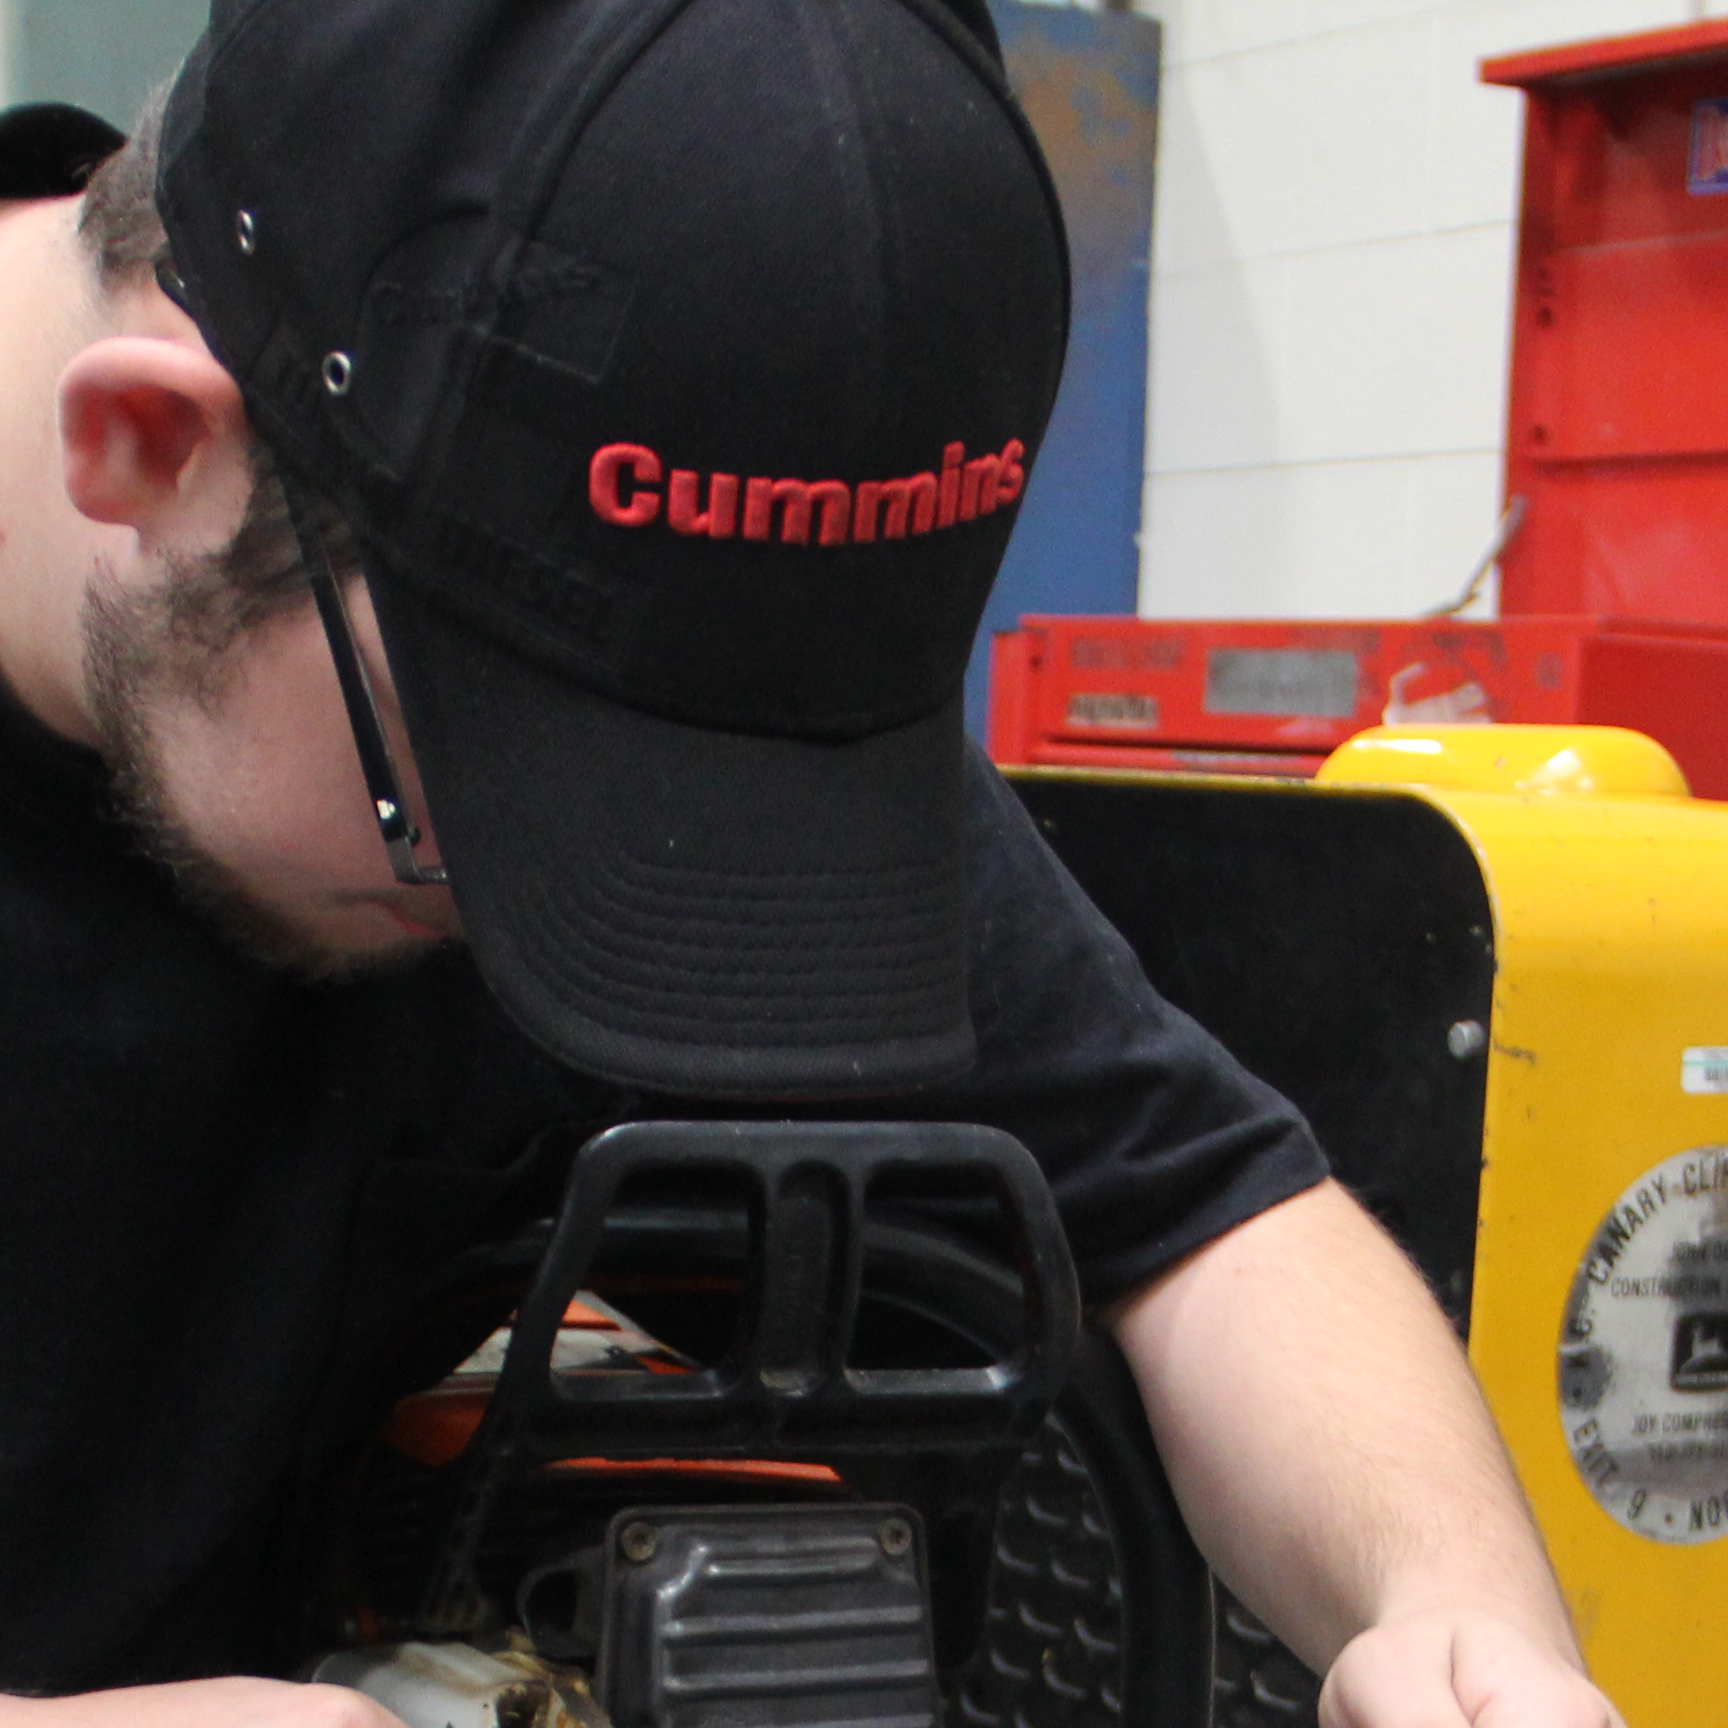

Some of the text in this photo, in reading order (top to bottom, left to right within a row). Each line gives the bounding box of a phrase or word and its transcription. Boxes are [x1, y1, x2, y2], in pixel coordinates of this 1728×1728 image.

[588, 436, 1026, 547] Cummins
[1573, 1418, 1647, 1521] EXIT 9
